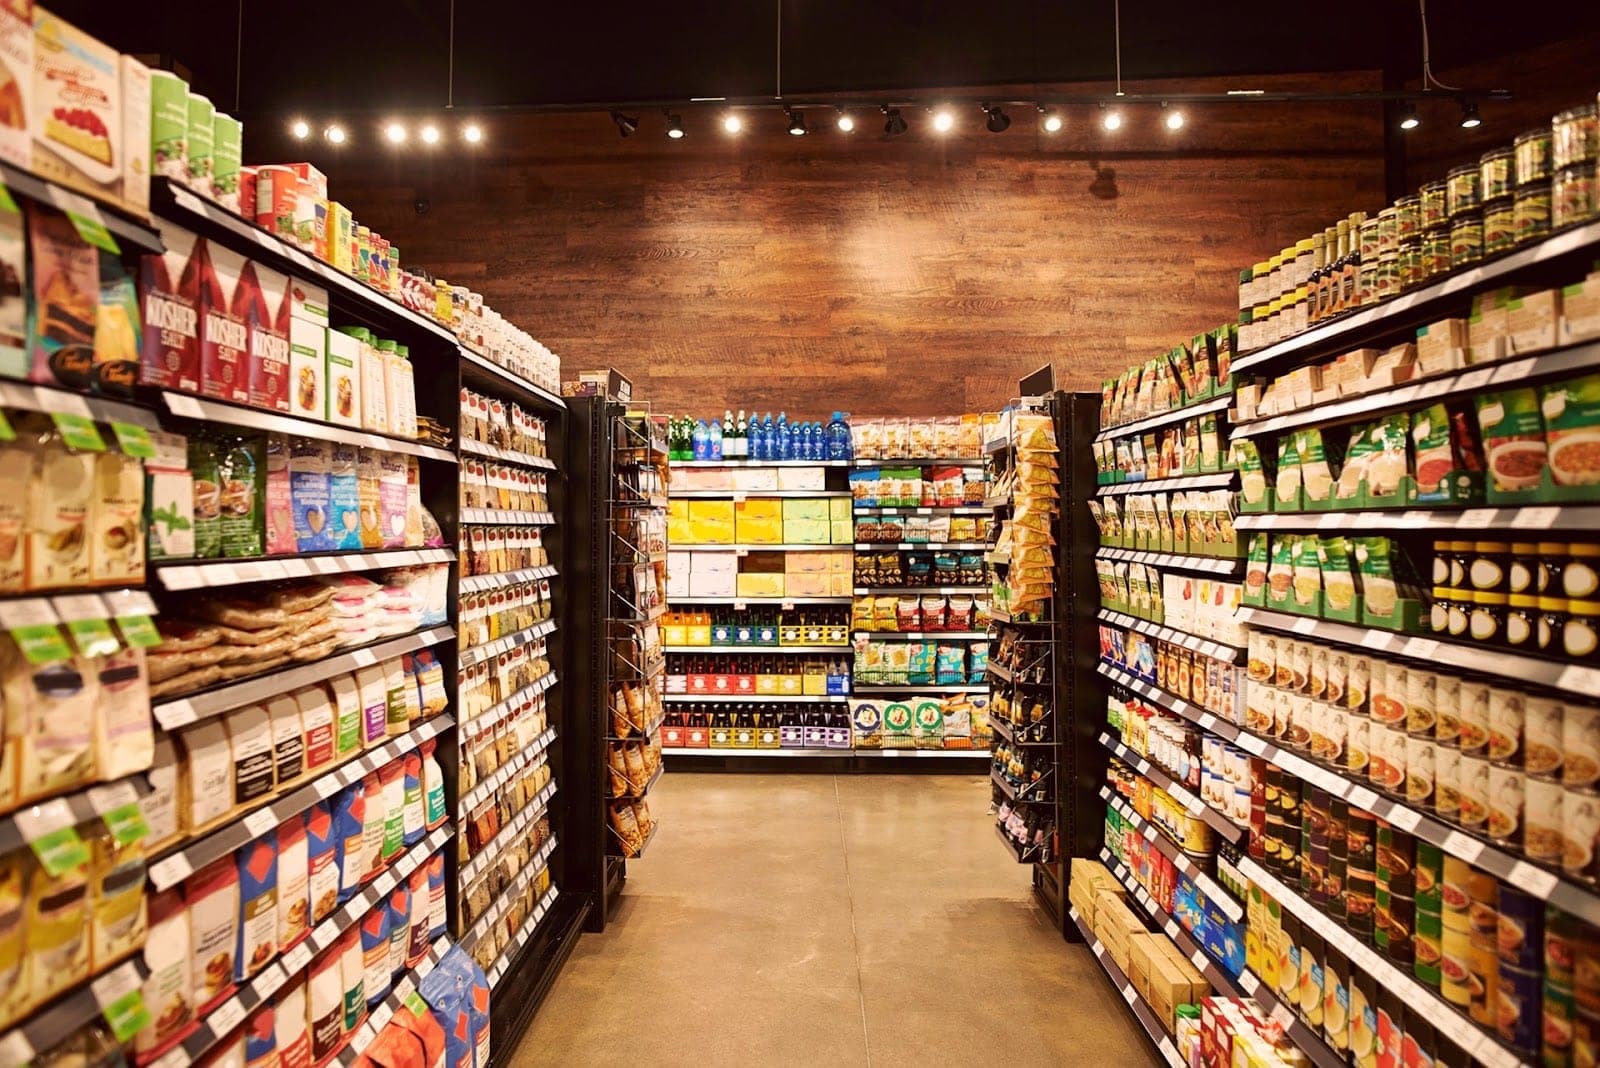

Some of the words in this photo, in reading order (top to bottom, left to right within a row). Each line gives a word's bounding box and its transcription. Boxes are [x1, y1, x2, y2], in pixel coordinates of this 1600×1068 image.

[146, 294, 198, 338] KOSHER
[160, 329, 186, 349] SALT
[206, 313, 248, 352] KOSHER
[217, 345, 238, 363] SALT
[252, 329, 290, 365] KOSHER
[263, 358, 281, 376] SALT
